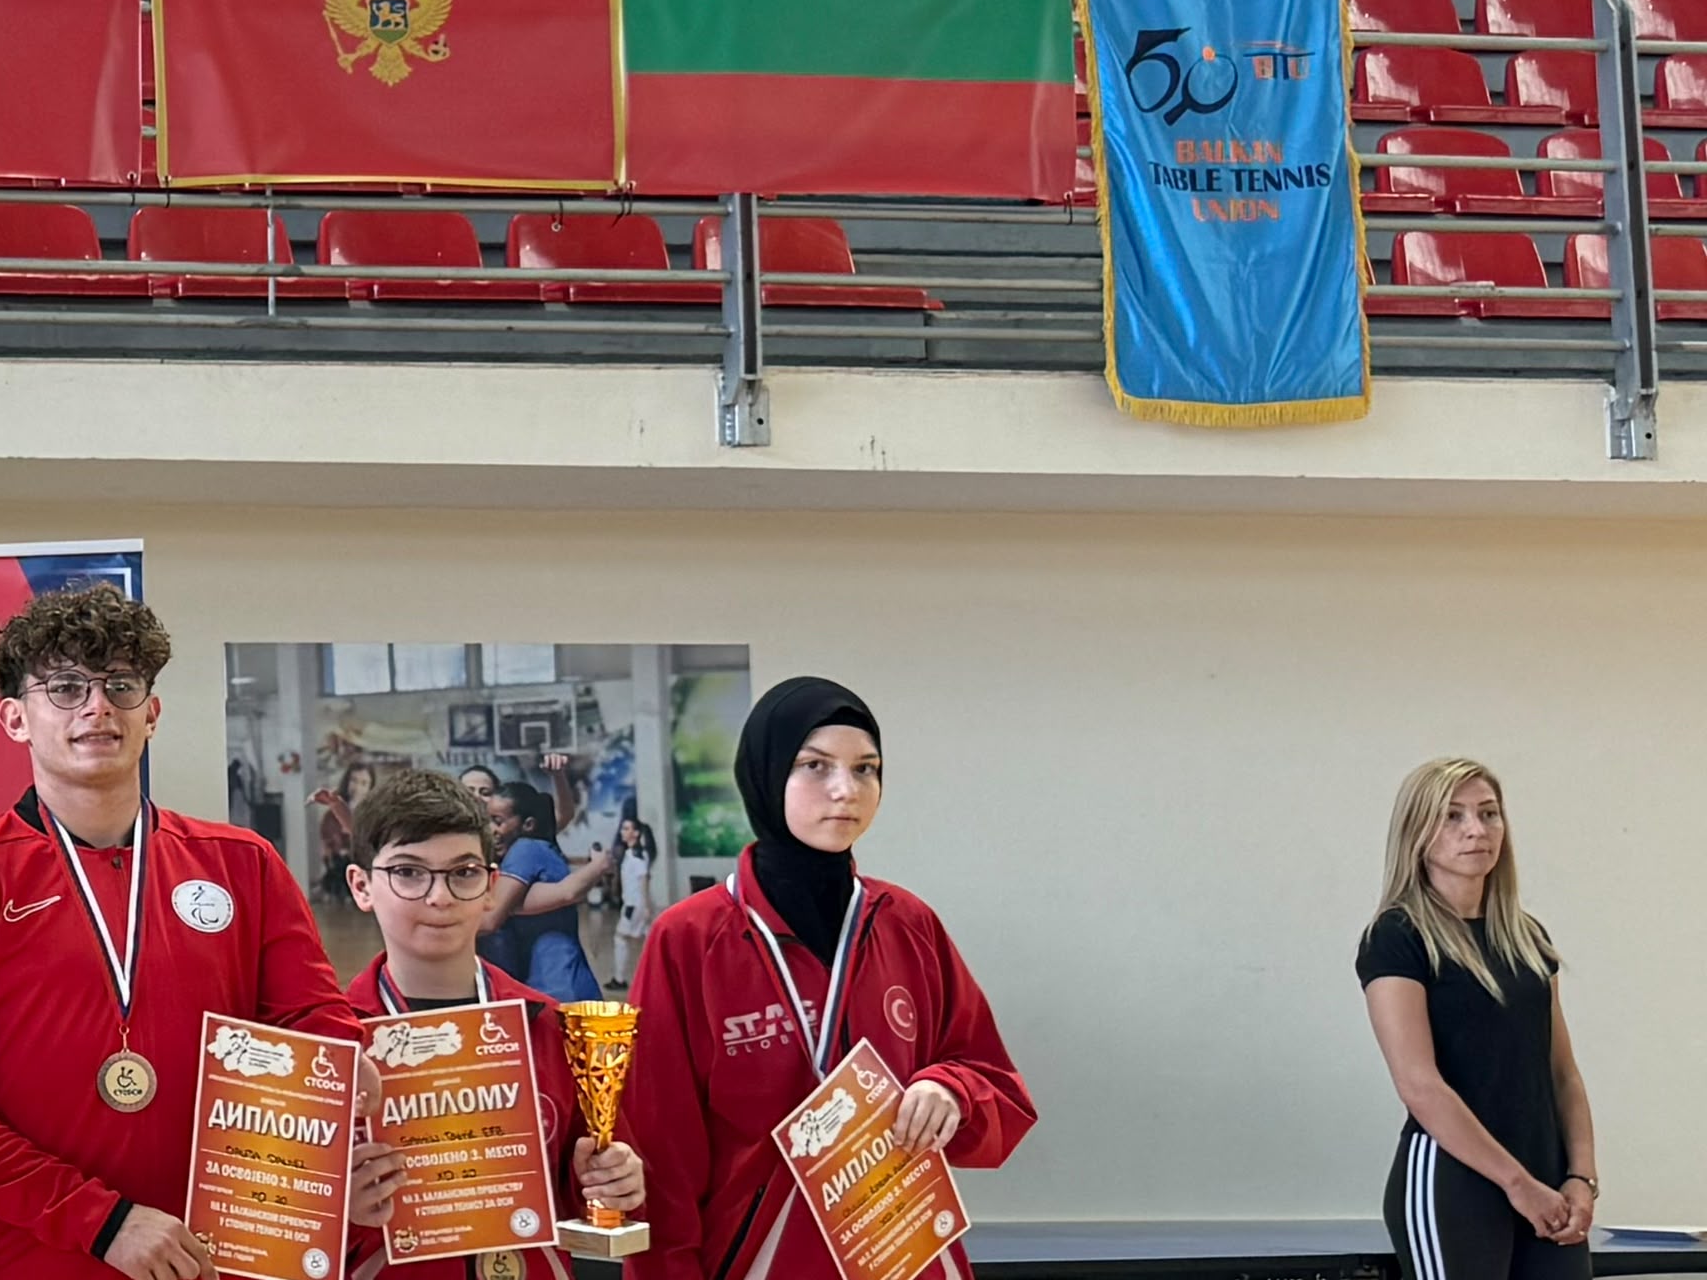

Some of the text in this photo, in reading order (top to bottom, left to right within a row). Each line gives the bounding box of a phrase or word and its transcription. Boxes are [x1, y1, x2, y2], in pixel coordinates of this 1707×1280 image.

[1176, 140, 1284, 164] BALKAN
[1149, 161, 1331, 192] TABLE TENNIS
[1191, 198, 1279, 222] UNION
[383, 1082, 519, 1127] ДИПЛОМУ
[208, 1098, 338, 1147] ДИПЛОМУ
[485, 1143, 527, 1158] МЕСТО
[205, 1160, 220, 1174] ЗА
[222, 1164, 279, 1186] ОСВОЈЕНО
[293, 1178, 333, 1196] МЕСТО
